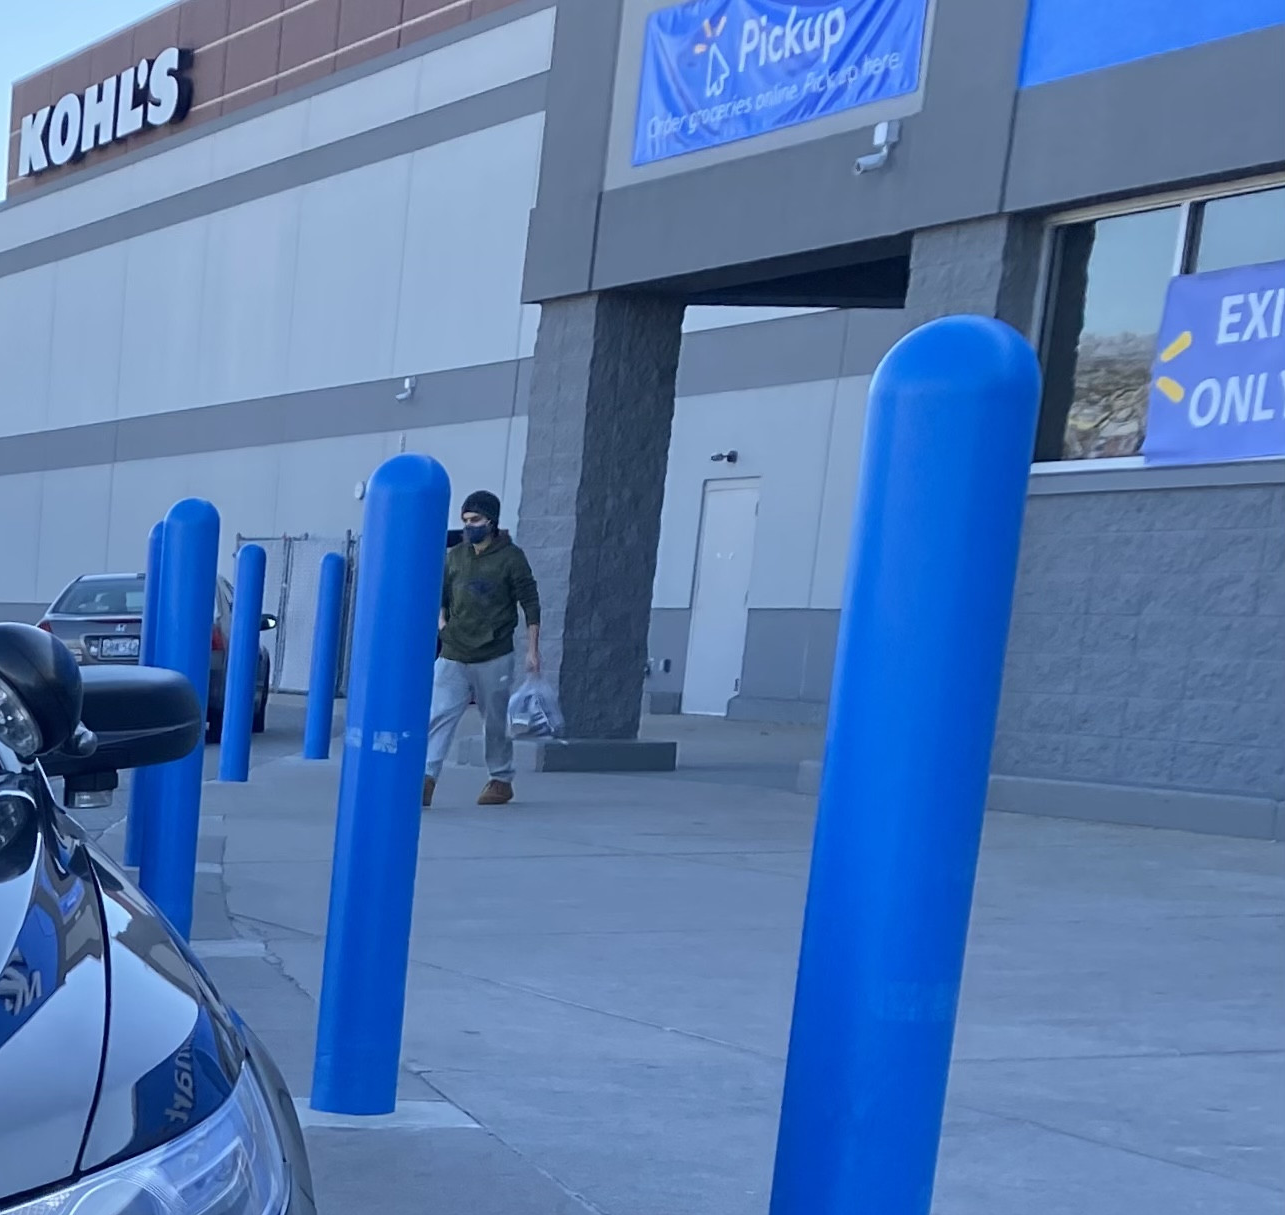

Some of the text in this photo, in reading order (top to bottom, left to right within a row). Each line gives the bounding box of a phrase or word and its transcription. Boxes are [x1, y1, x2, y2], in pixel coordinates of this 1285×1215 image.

[738, 5, 846, 73] Pickup
[18, 46, 180, 177] KOHL'S
[647, 112, 687, 138] Order
[687, 94, 752, 135] groceries
